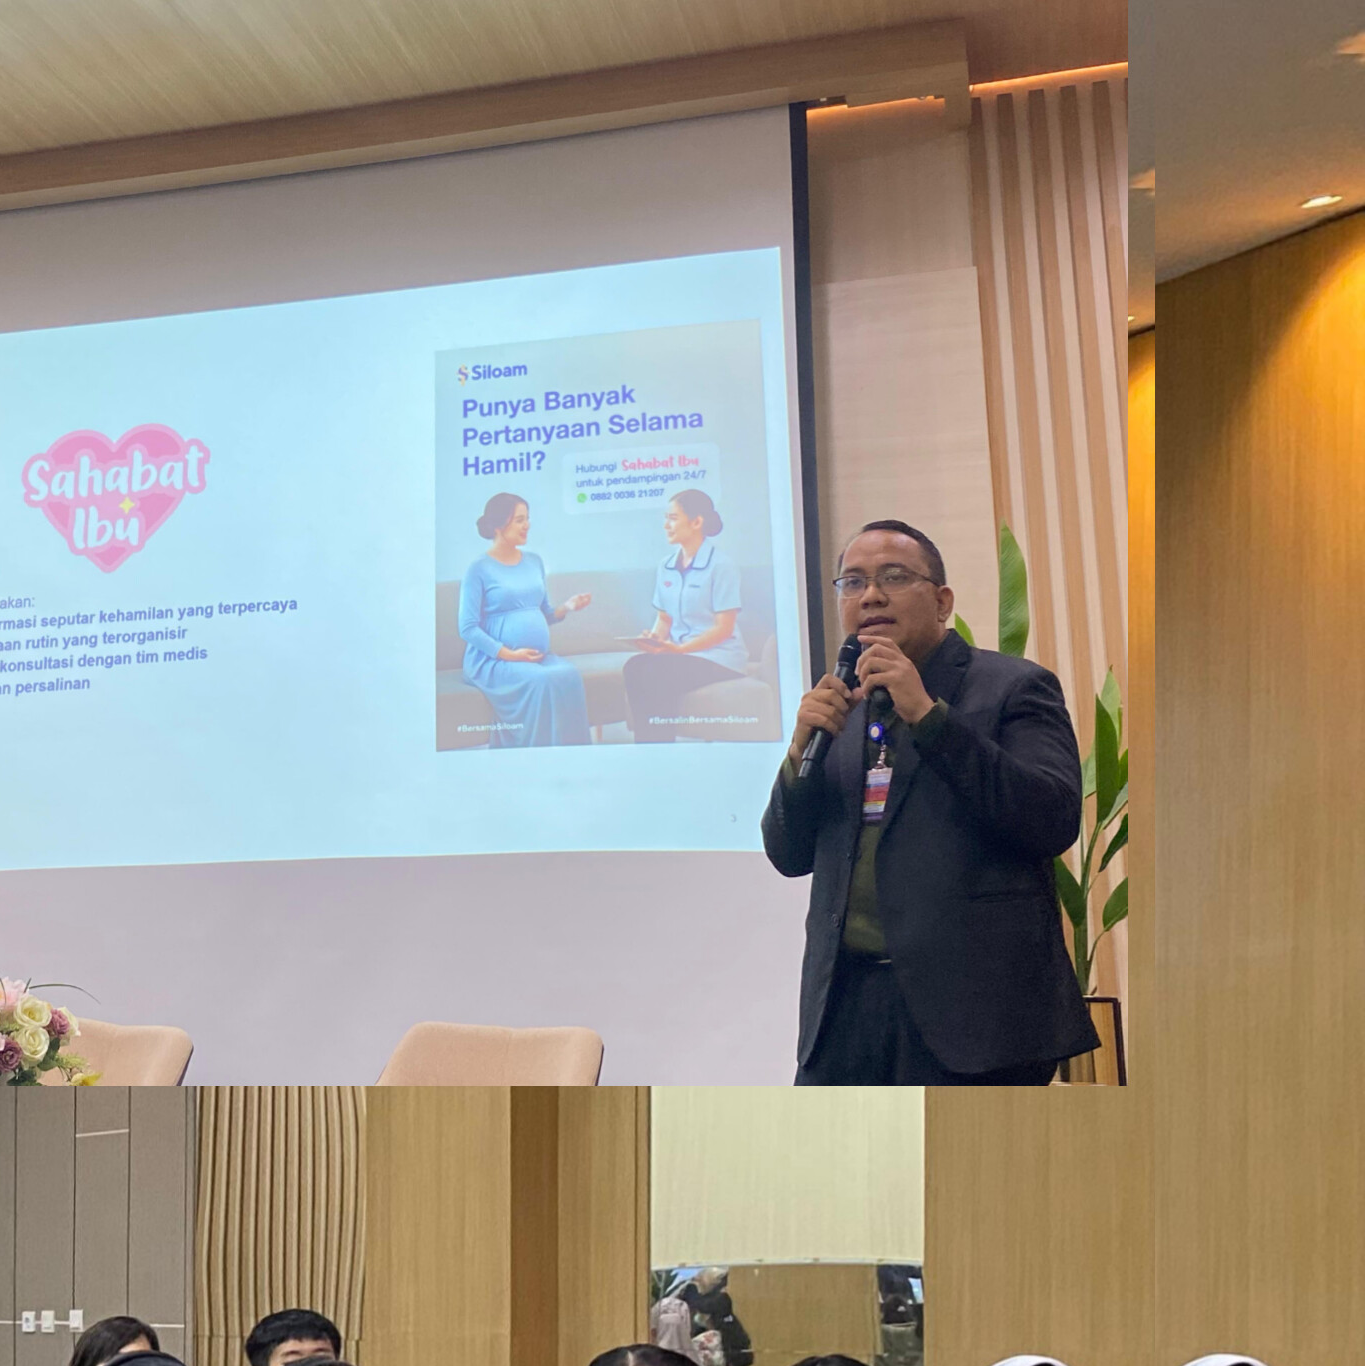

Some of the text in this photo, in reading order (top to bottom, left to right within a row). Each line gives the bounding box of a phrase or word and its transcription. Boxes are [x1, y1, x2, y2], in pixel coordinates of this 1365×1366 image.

[471, 364, 528, 381] Siloam
[463, 384, 636, 419] Punya Banyak
[463, 412, 704, 447] Pertanyaan Selama
[28, 445, 204, 501] Sahabat
[463, 450, 546, 477] Hamil?
[576, 454, 699, 474] Hubungi Sahabat Ibu
[576, 470, 707, 488] untuk pendampingan 24/7
[638, 488, 665, 498] 21207
[73, 505, 139, 549] Ibu
[40, 612, 95, 629] seputar
[99, 607, 174, 624] kehamilan
[177, 603, 214, 621] yang
[218, 599, 298, 616] terpercaya
[25, 634, 59, 650] rutin
[62, 633, 98, 650] yang
[102, 626, 188, 645] terorganisir
[77, 654, 132, 669] dengan
[136, 650, 159, 664] tim
[163, 646, 208, 662] medis
[15, 677, 90, 696] persalinan
[649, 715, 759, 725] #BersalinBersamaSiloam
